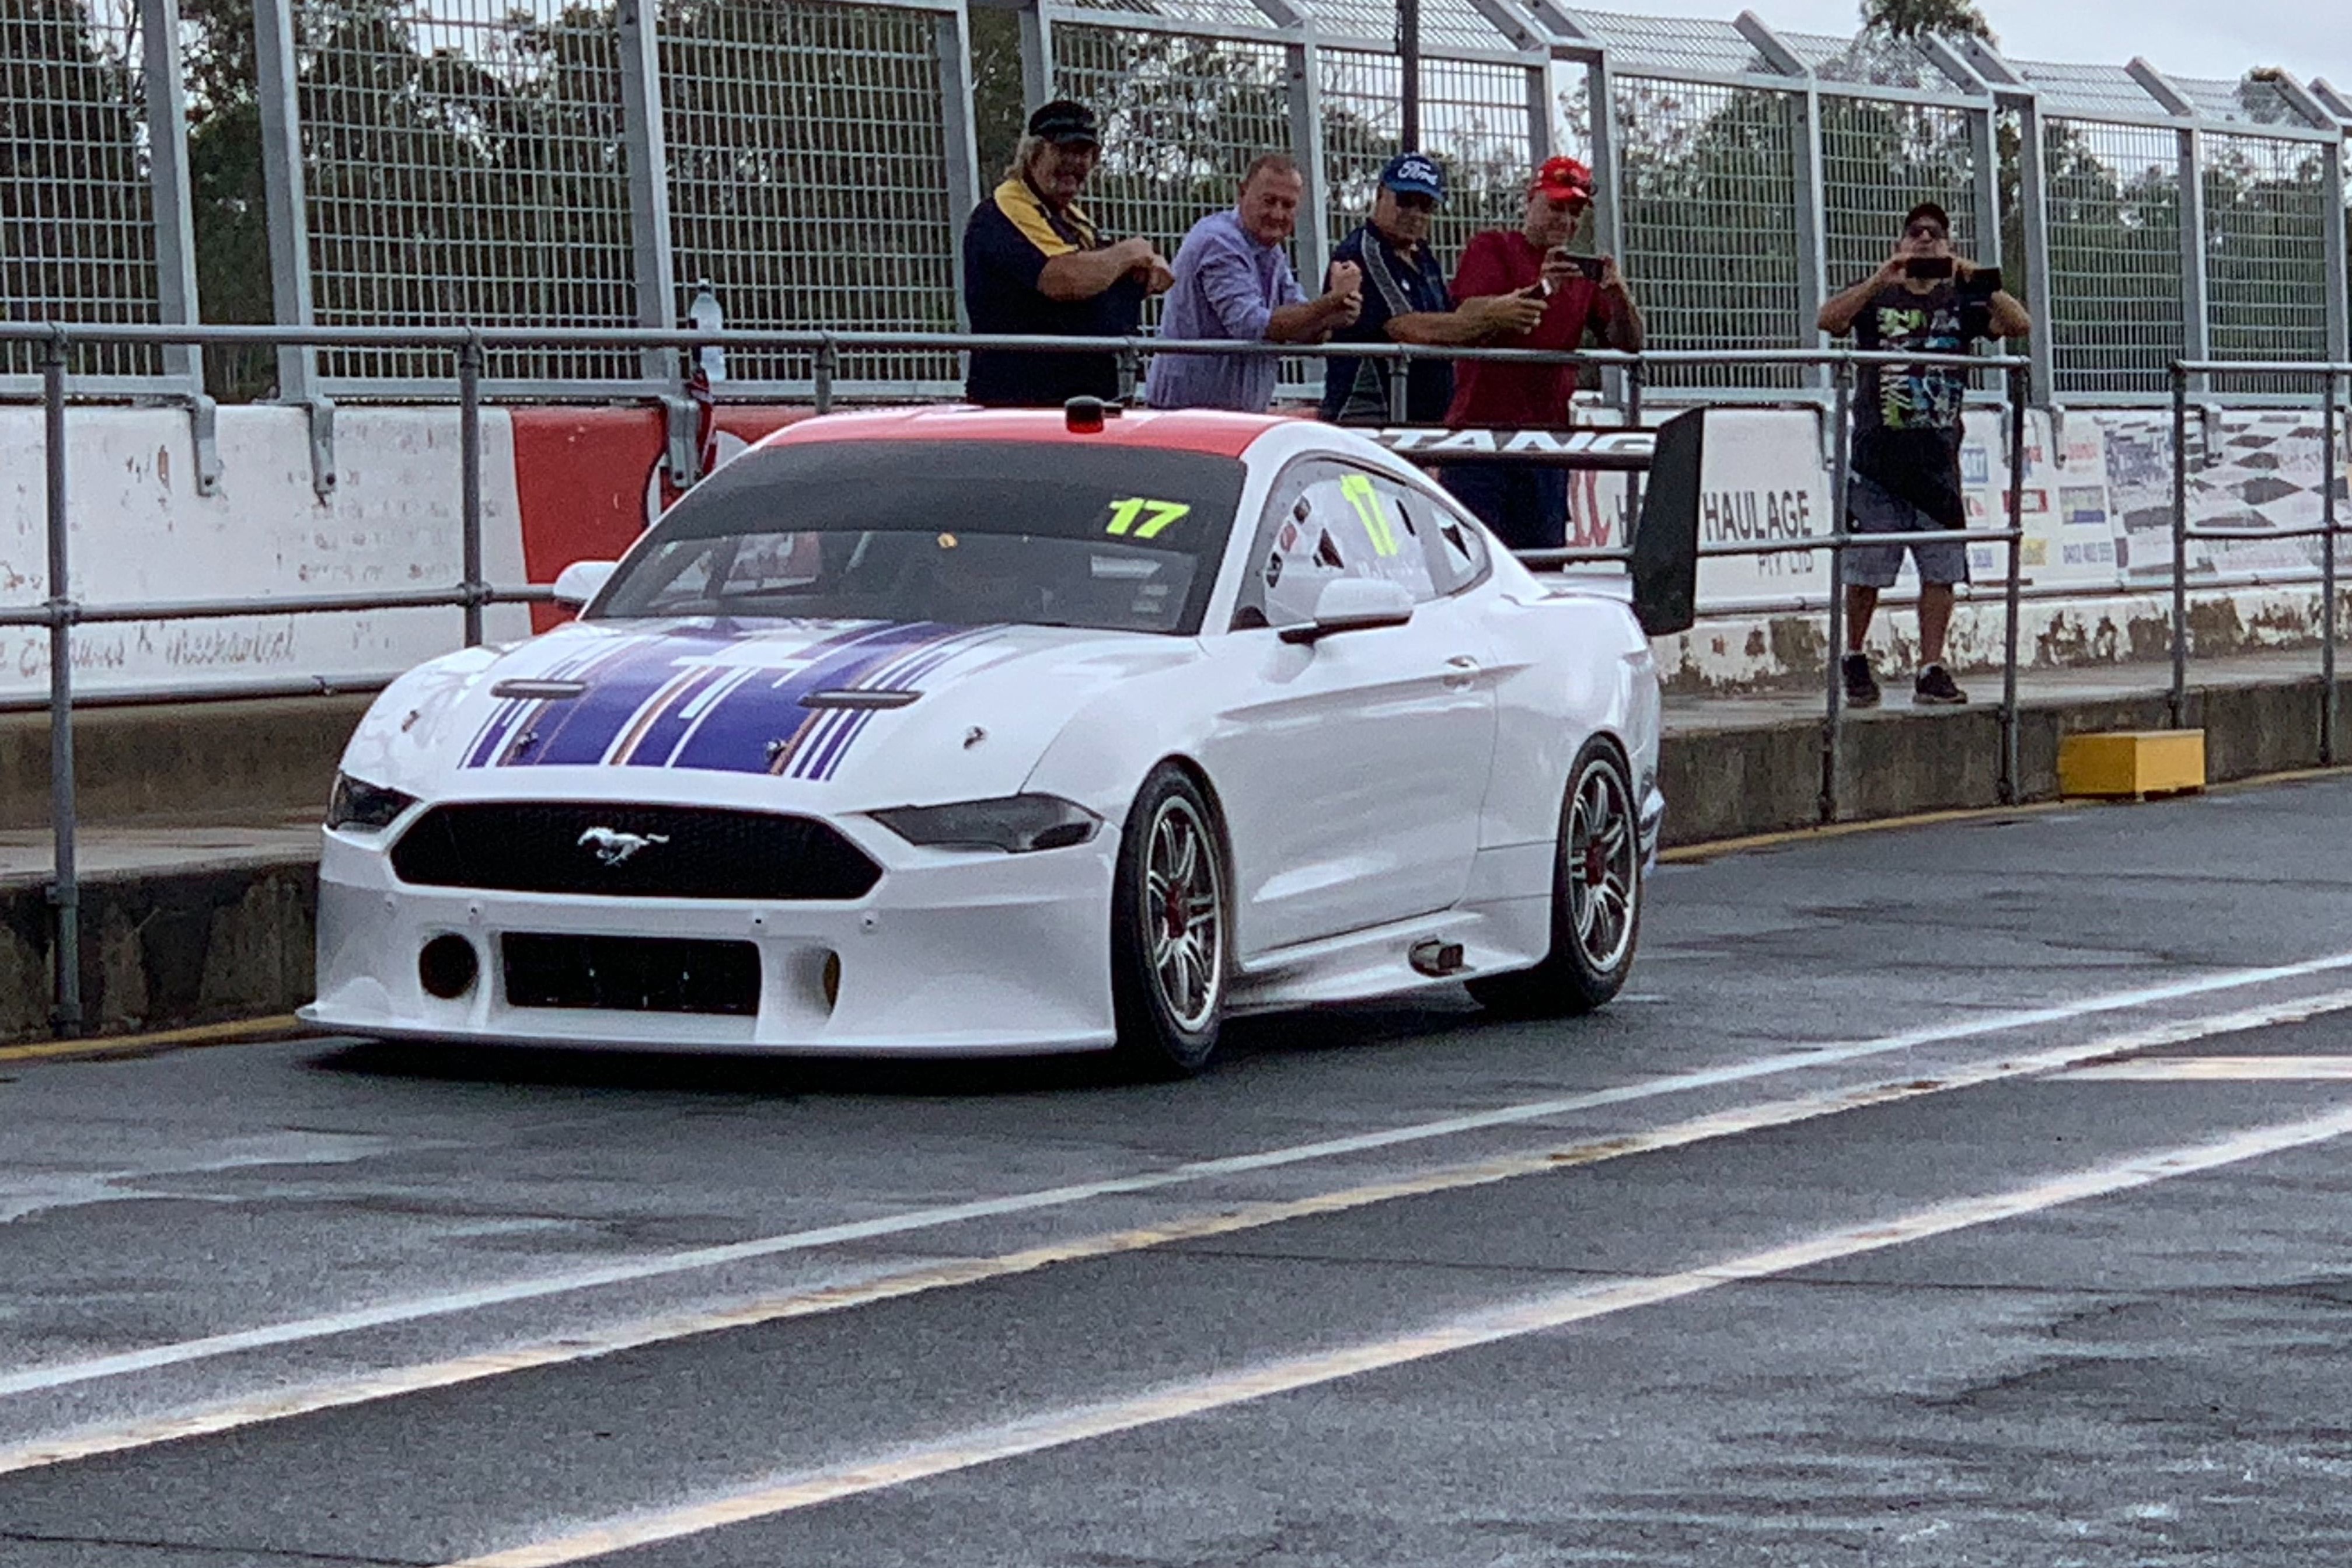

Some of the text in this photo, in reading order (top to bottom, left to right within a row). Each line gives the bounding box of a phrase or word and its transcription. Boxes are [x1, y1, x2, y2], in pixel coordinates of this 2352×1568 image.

[1397, 160, 1438, 186] Ford
[1355, 427, 1657, 453] TANG
[1106, 497, 1191, 539] 17
[1702, 489, 1813, 543] HAULAGE
